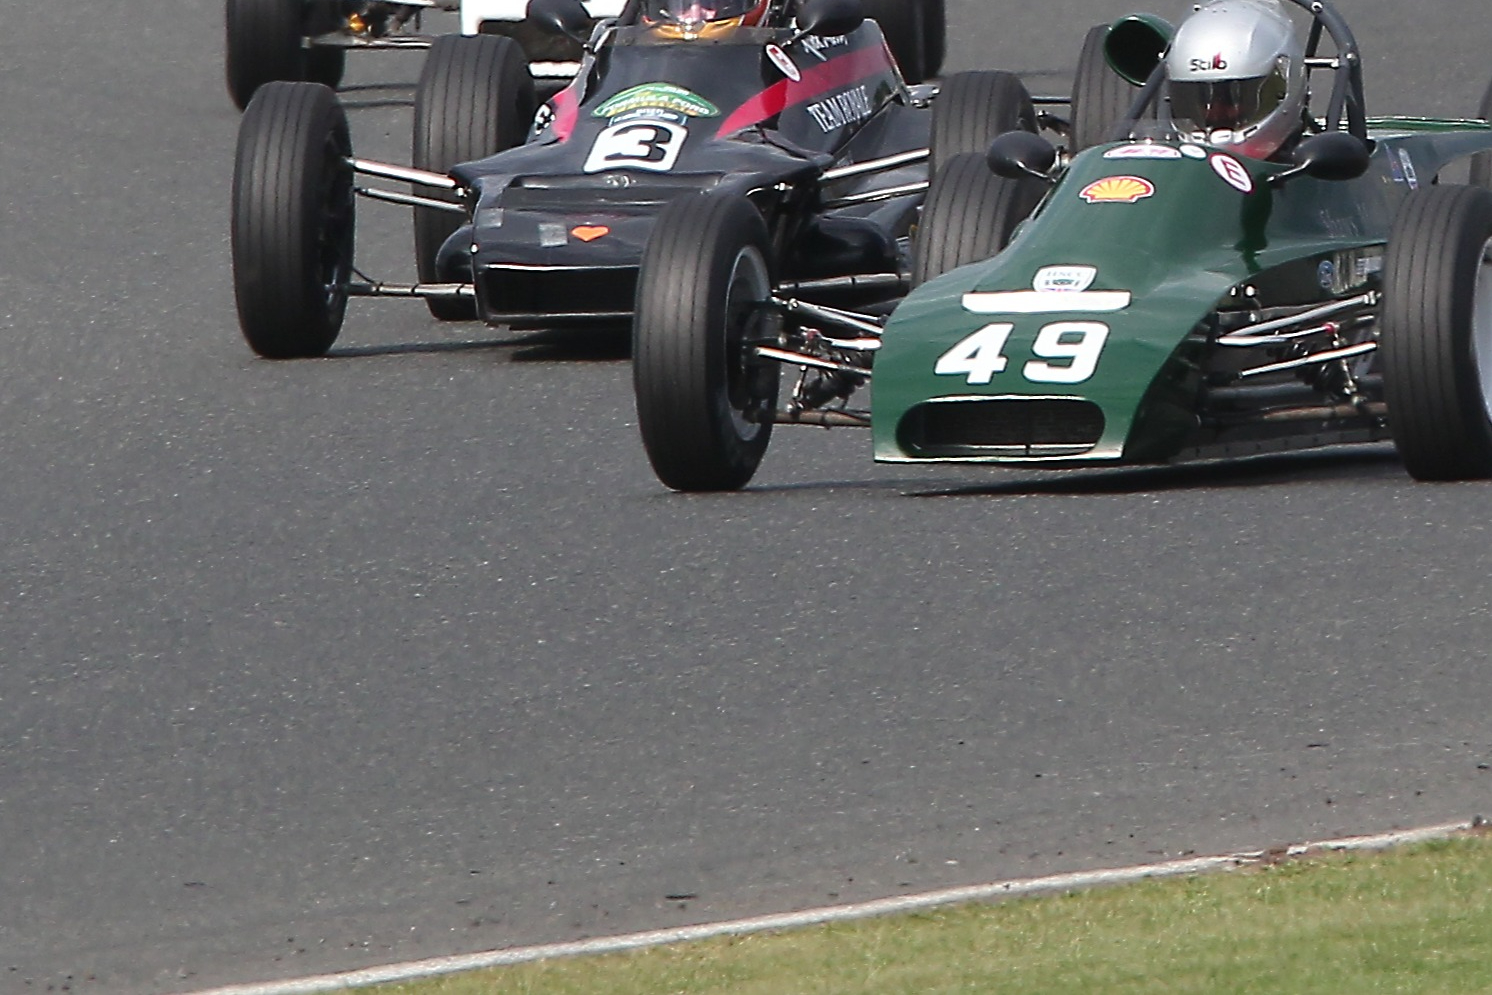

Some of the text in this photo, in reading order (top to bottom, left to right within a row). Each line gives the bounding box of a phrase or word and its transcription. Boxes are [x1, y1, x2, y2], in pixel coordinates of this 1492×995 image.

[1189, 51, 1228, 72] Stilo
[604, 124, 673, 163] 3
[934, 321, 1110, 384] 49
